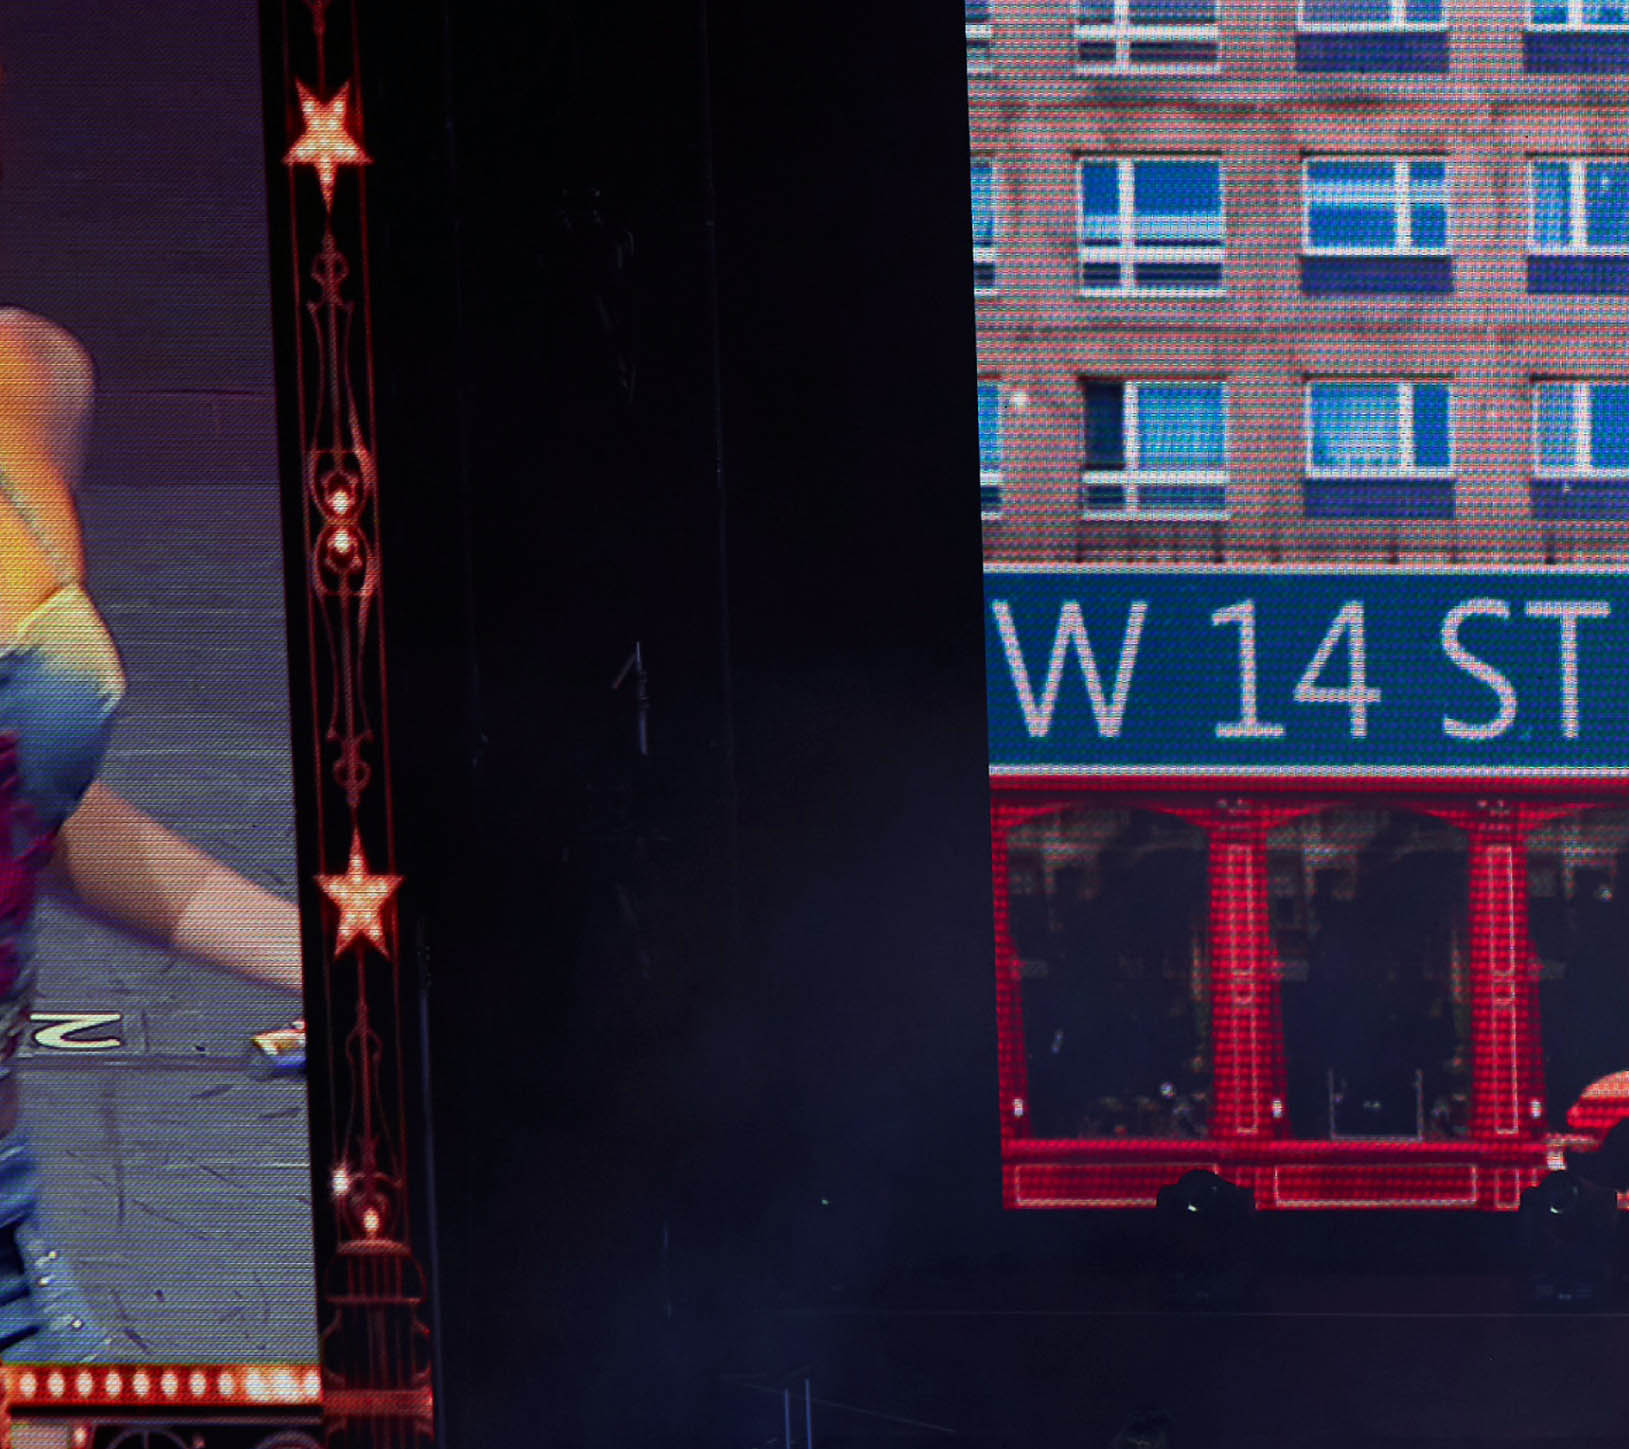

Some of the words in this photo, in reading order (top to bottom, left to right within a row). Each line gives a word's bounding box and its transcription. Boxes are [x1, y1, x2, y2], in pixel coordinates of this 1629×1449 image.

[990, 598, 1149, 739] W
[1210, 597, 1383, 740] 14
[1439, 596, 1611, 741] ST
